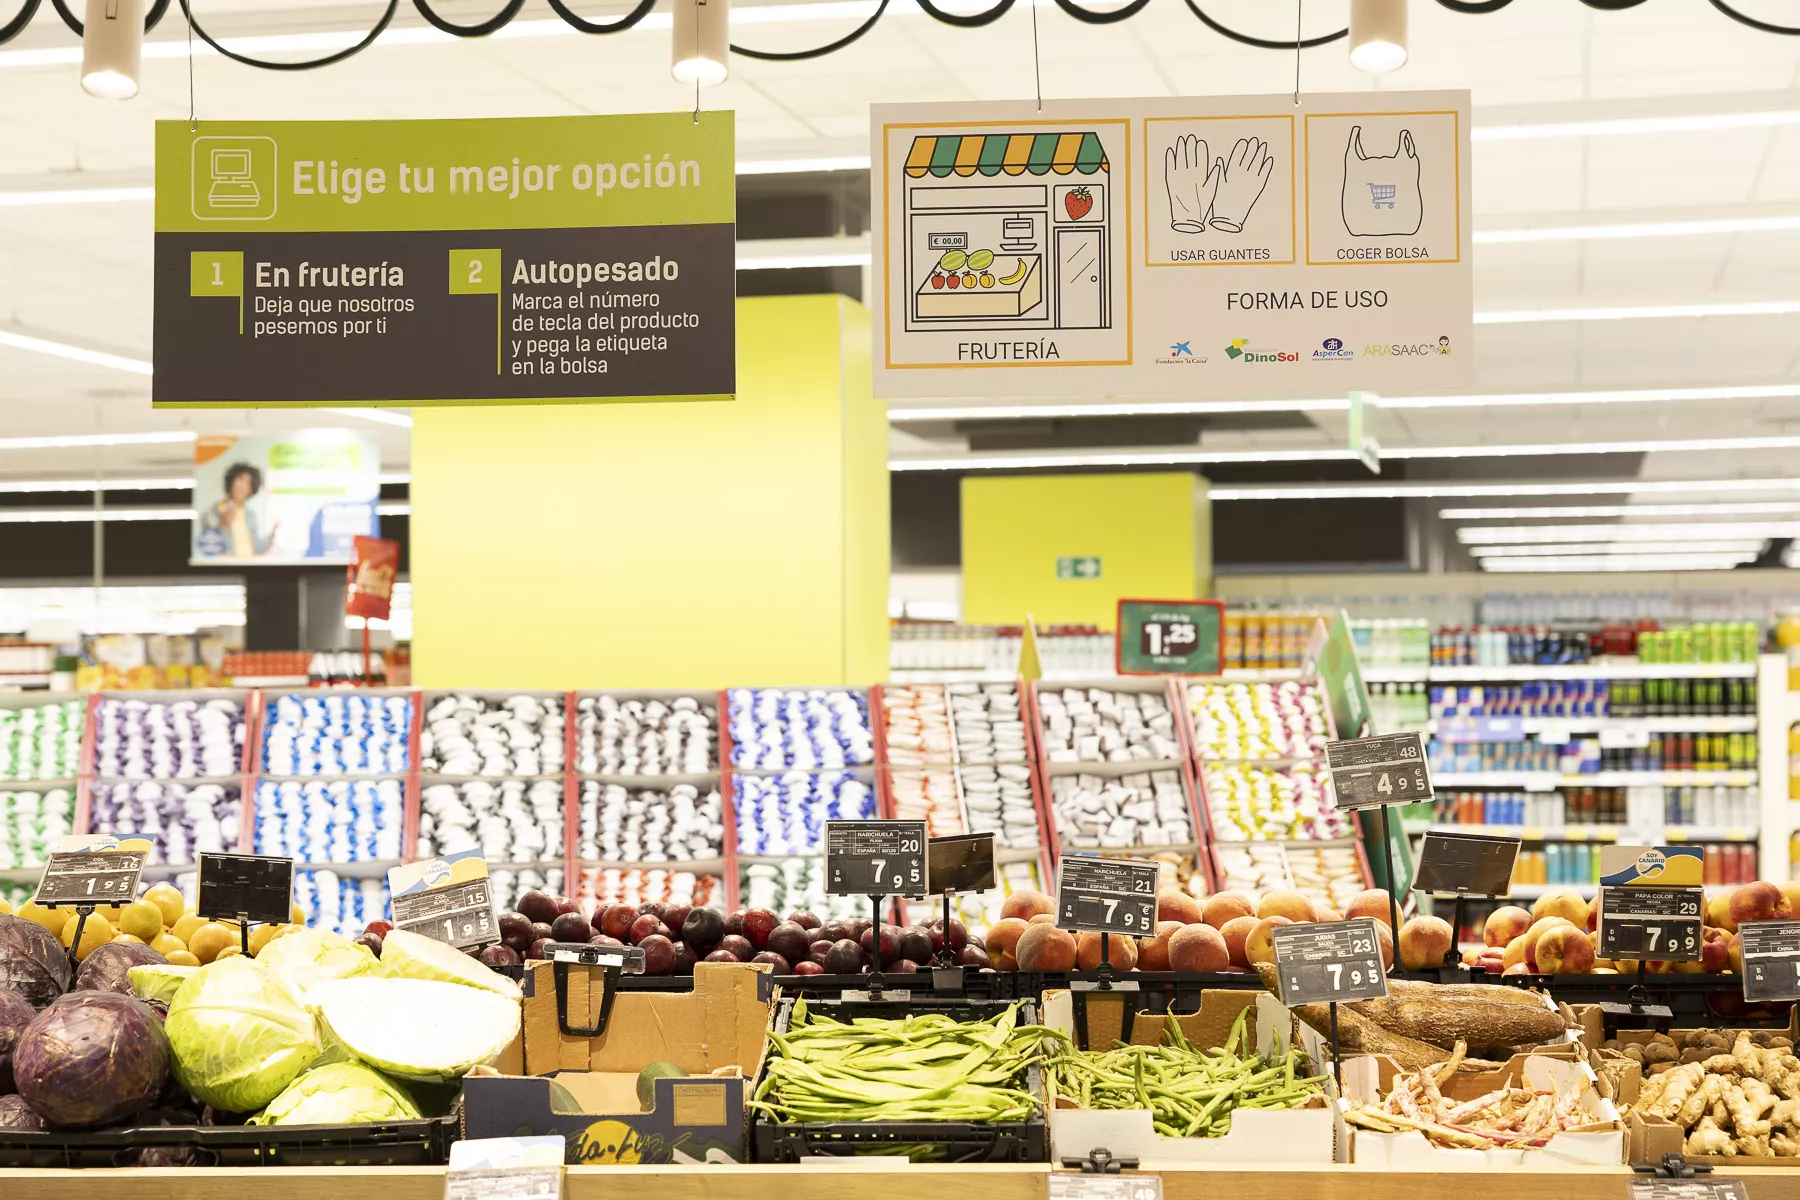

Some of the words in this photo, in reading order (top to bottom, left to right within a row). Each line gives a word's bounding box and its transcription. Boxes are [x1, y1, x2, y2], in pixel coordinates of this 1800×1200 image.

[294, 161, 385, 204] Elige
[400, 163, 434, 193] tu
[450, 158, 561, 199] mejor
[573, 154, 700, 197] opción
[1171, 250, 1205, 261] USAR
[1209, 249, 1270, 260] GUANTES
[1337, 248, 1381, 259] COGER
[1386, 247, 1428, 258] BOLSA
[211, 263, 223, 285] 1
[256, 263, 289, 287] En
[299, 261, 403, 287] frutería
[469, 260, 482, 283] 2
[512, 256, 678, 287] Autopesado
[255, 296, 292, 316] Deja
[299, 300, 331, 316] que
[339, 297, 414, 312] nosotros
[513, 293, 562, 309] Marca
[569, 292, 584, 308] el
[590, 291, 659, 308] número
[1228, 292, 1304, 310] FORMA
[1312, 291, 1338, 308] DE
[1346, 291, 1387, 307] USO
[255, 321, 337, 338] pesemos
[344, 321, 372, 337] por
[377, 317, 386, 333] ti
[513, 315, 533, 331] de
[540, 314, 581, 330] tecla
[588, 313, 614, 329] del
[621, 311, 698, 333] producto
[512, 340, 521, 356] y
[527, 339, 569, 356] pega
[576, 335, 590, 351] la
[597, 332, 667, 354] etiqueta
[959, 342, 1060, 360] FRUTERÍA
[1363, 344, 1428, 356] ARASAAC
[512, 362, 533, 374] en
[541, 356, 556, 374] la
[561, 357, 607, 374] bolsa
[1244, 352, 1299, 362] DinoSol
[1400, 746, 1416, 757] 48
[1377, 773, 1393, 794] 4
[901, 840, 918, 852] 20
[121, 861, 138, 869] 16
[871, 859, 886, 882] 7
[893, 875, 902, 888] 9
[911, 869, 919, 882] 5
[86, 878, 96, 894] 1
[104, 881, 114, 889] 9
[119, 882, 129, 891] 5
[1135, 880, 1152, 892] 21
[467, 893, 484, 905] 15
[1680, 902, 1697, 914] 29
[1104, 900, 1118, 923] 7
[1124, 913, 1133, 926] 9
[1140, 917, 1149, 930] 5
[1143, 906, 1149, 915] €
[444, 919, 454, 940] 1
[463, 924, 473, 936] 9
[480, 919, 489, 930] 5
[1353, 939, 1371, 953] 23
[1646, 928, 1661, 951] 7
[1669, 939, 1678, 952] 9
[1685, 937, 1694, 949] 9
[1327, 964, 1342, 990] 7
[1351, 971, 1361, 985] 9
[1368, 970, 1379, 983] 5
